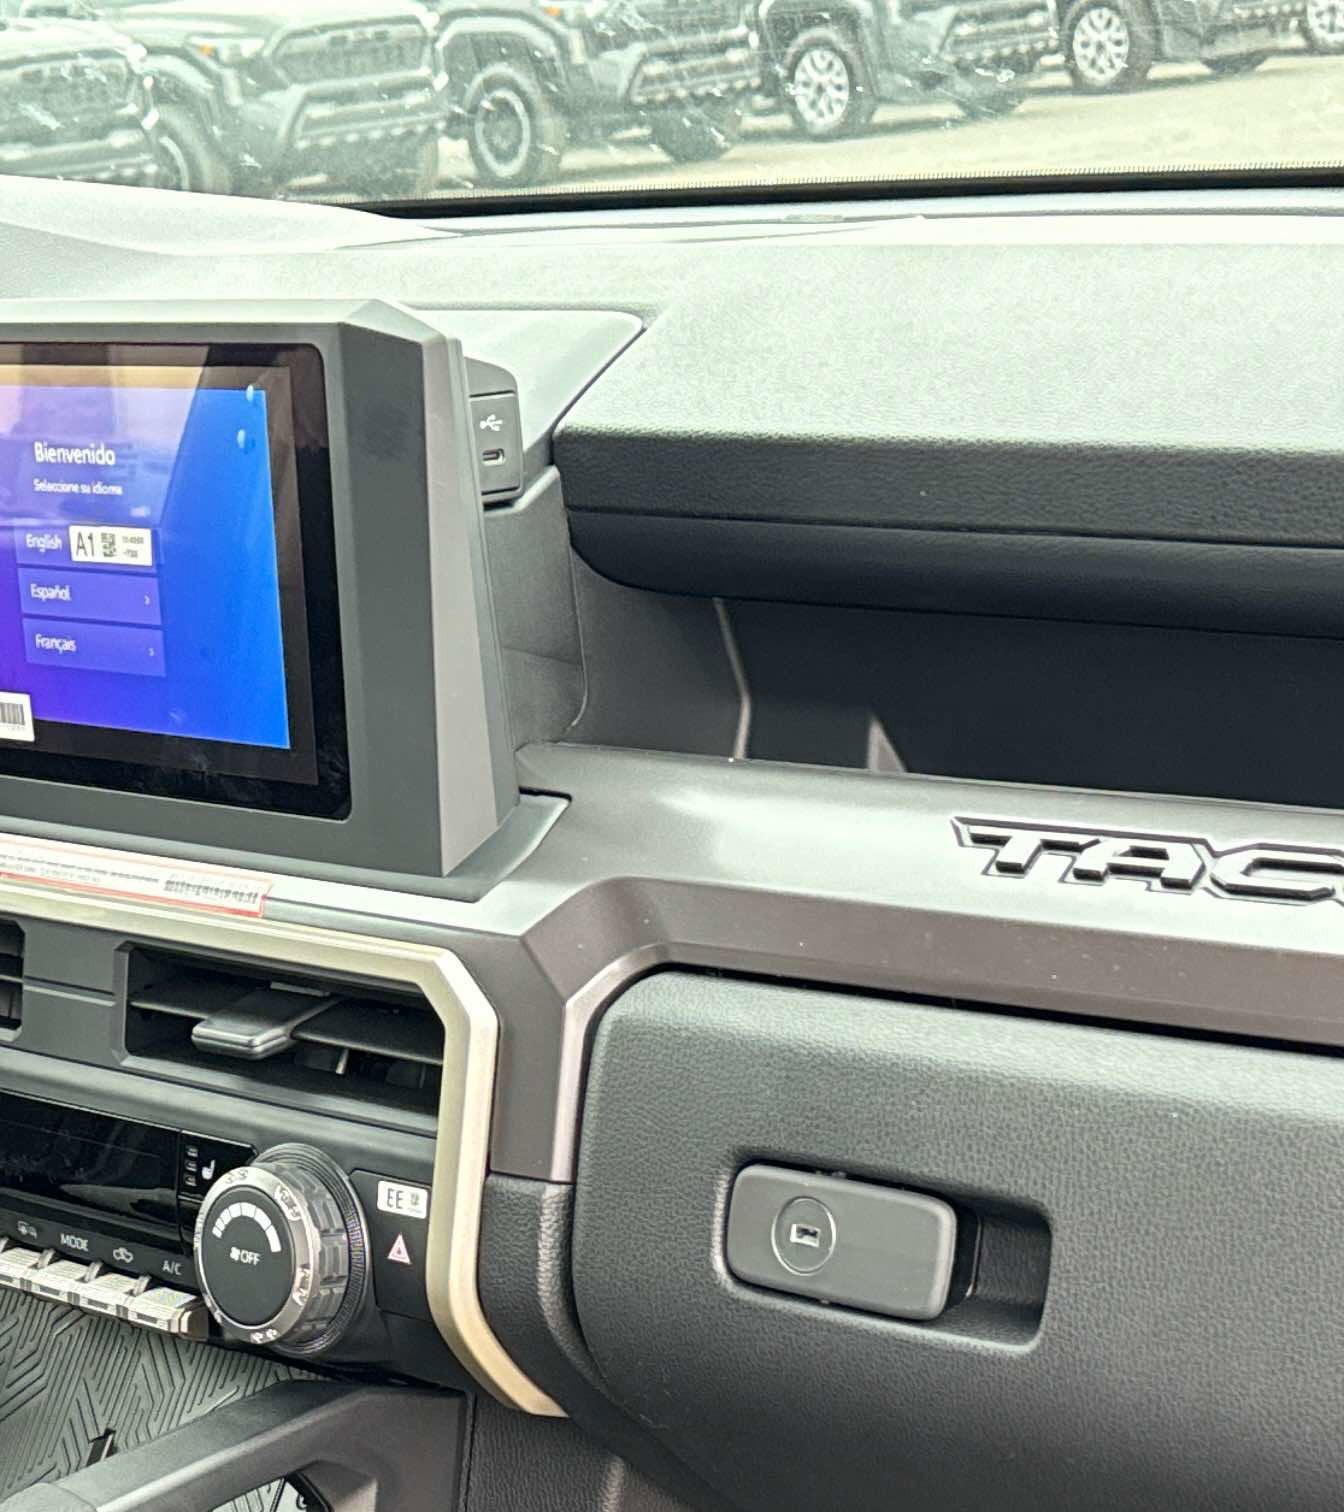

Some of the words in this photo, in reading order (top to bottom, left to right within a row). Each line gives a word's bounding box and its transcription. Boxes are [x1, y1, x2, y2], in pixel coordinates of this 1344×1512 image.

[33, 440, 116, 466] Bienvenido
[25, 532, 63, 553] English
[76, 531, 96, 558] A1
[29, 583, 72, 602] Español
[35, 633, 78, 655] Français
[386, 1187, 405, 1210] EE
[60, 1232, 90, 1252] MODE
[162, 1260, 182, 1276] A/C
[240, 1250, 261, 1266] OFF
